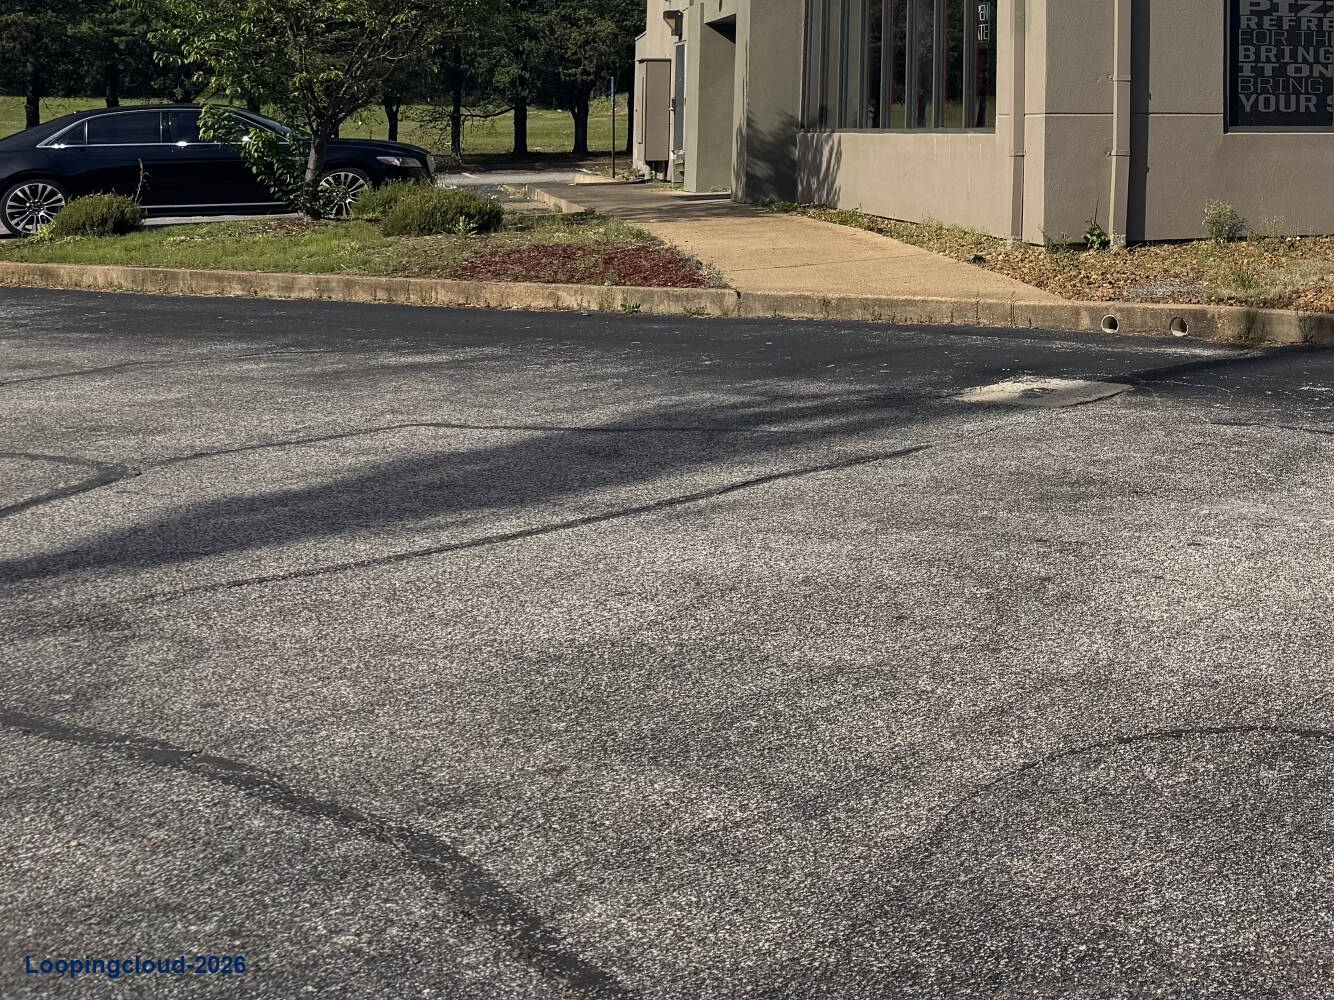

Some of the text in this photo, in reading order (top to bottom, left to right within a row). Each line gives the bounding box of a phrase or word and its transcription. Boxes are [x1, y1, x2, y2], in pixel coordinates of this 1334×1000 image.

[1239, 29, 1287, 46] FOR
[1296, 30, 1334, 47] TH
[1238, 46, 1334, 63] BRING
[1238, 62, 1280, 77] IT
[1238, 77, 1323, 94] BRING
[1238, 94, 1317, 113] YOUR
